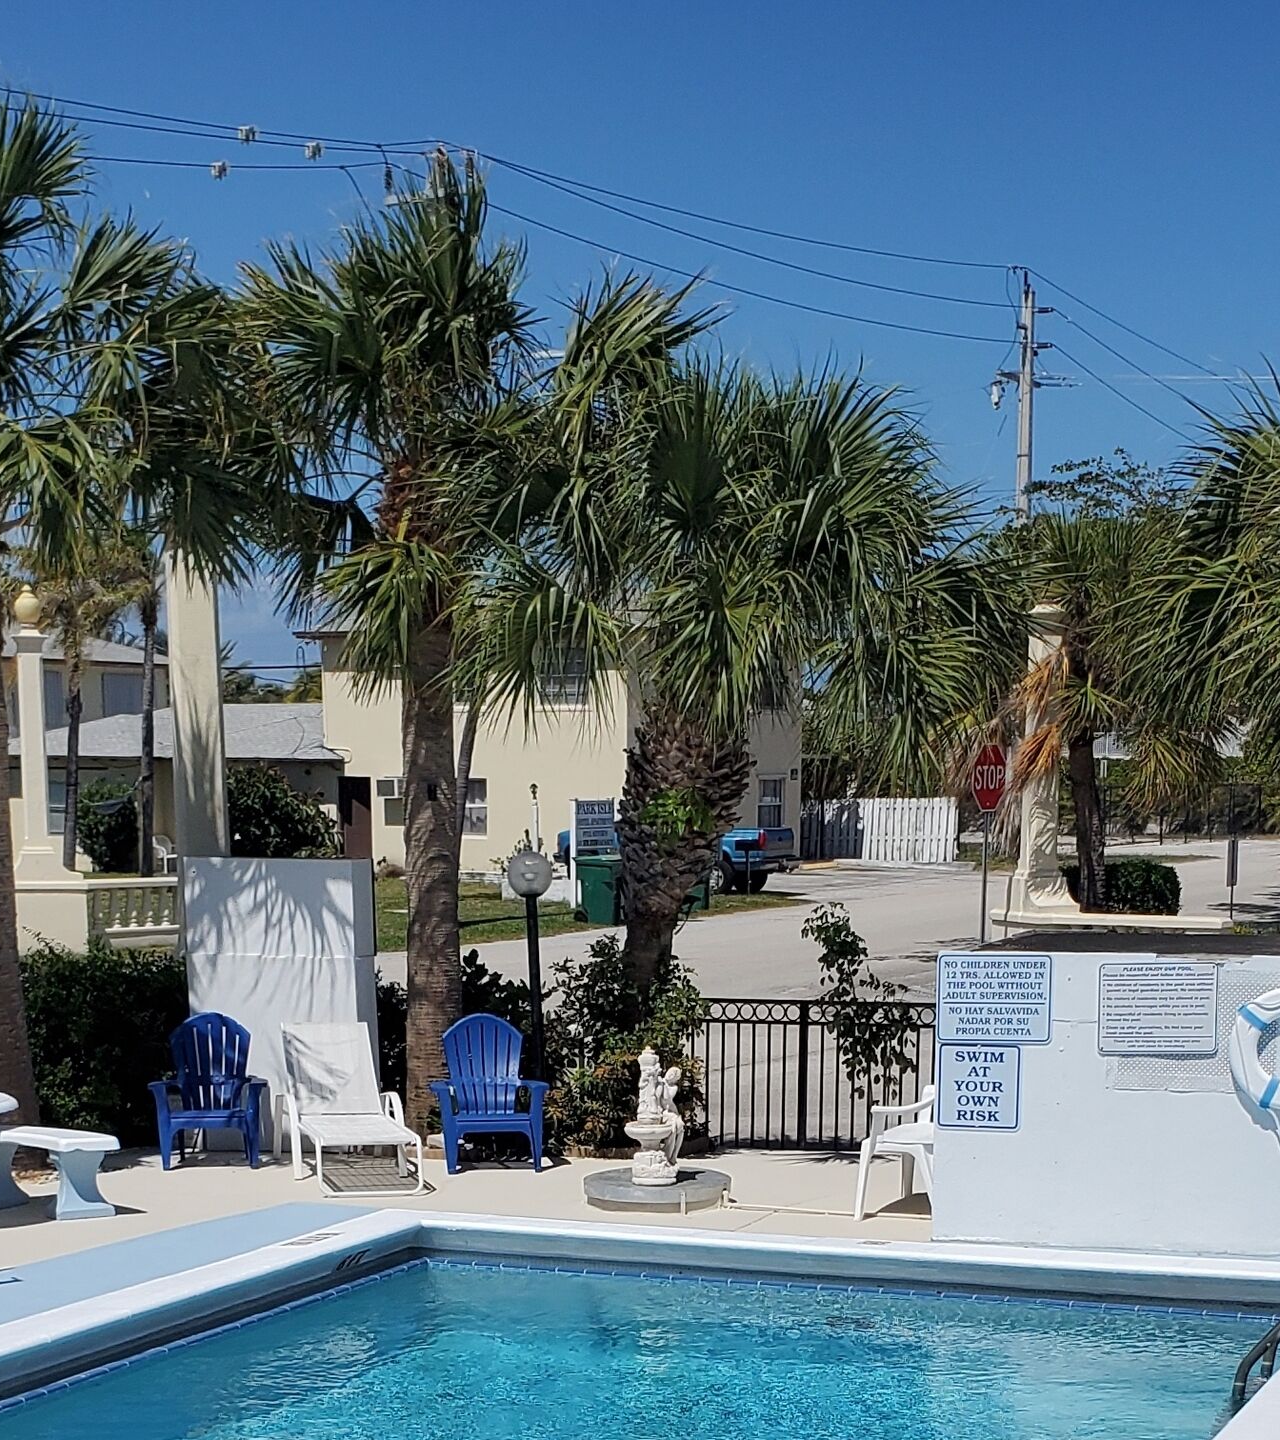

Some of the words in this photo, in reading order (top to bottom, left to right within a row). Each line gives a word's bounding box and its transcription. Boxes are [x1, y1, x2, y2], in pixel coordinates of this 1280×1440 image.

[975, 765, 1004, 790] STOP
[998, 982, 1042, 990] WITHOUT
[946, 992, 976, 1000] ADULT
[955, 1051, 1005, 1063] SWIM
[967, 1066, 991, 1077] AT
[954, 1080, 1003, 1092] YOUR
[958, 1095, 1000, 1107] OWN
[957, 1110, 1000, 1121] RISK
